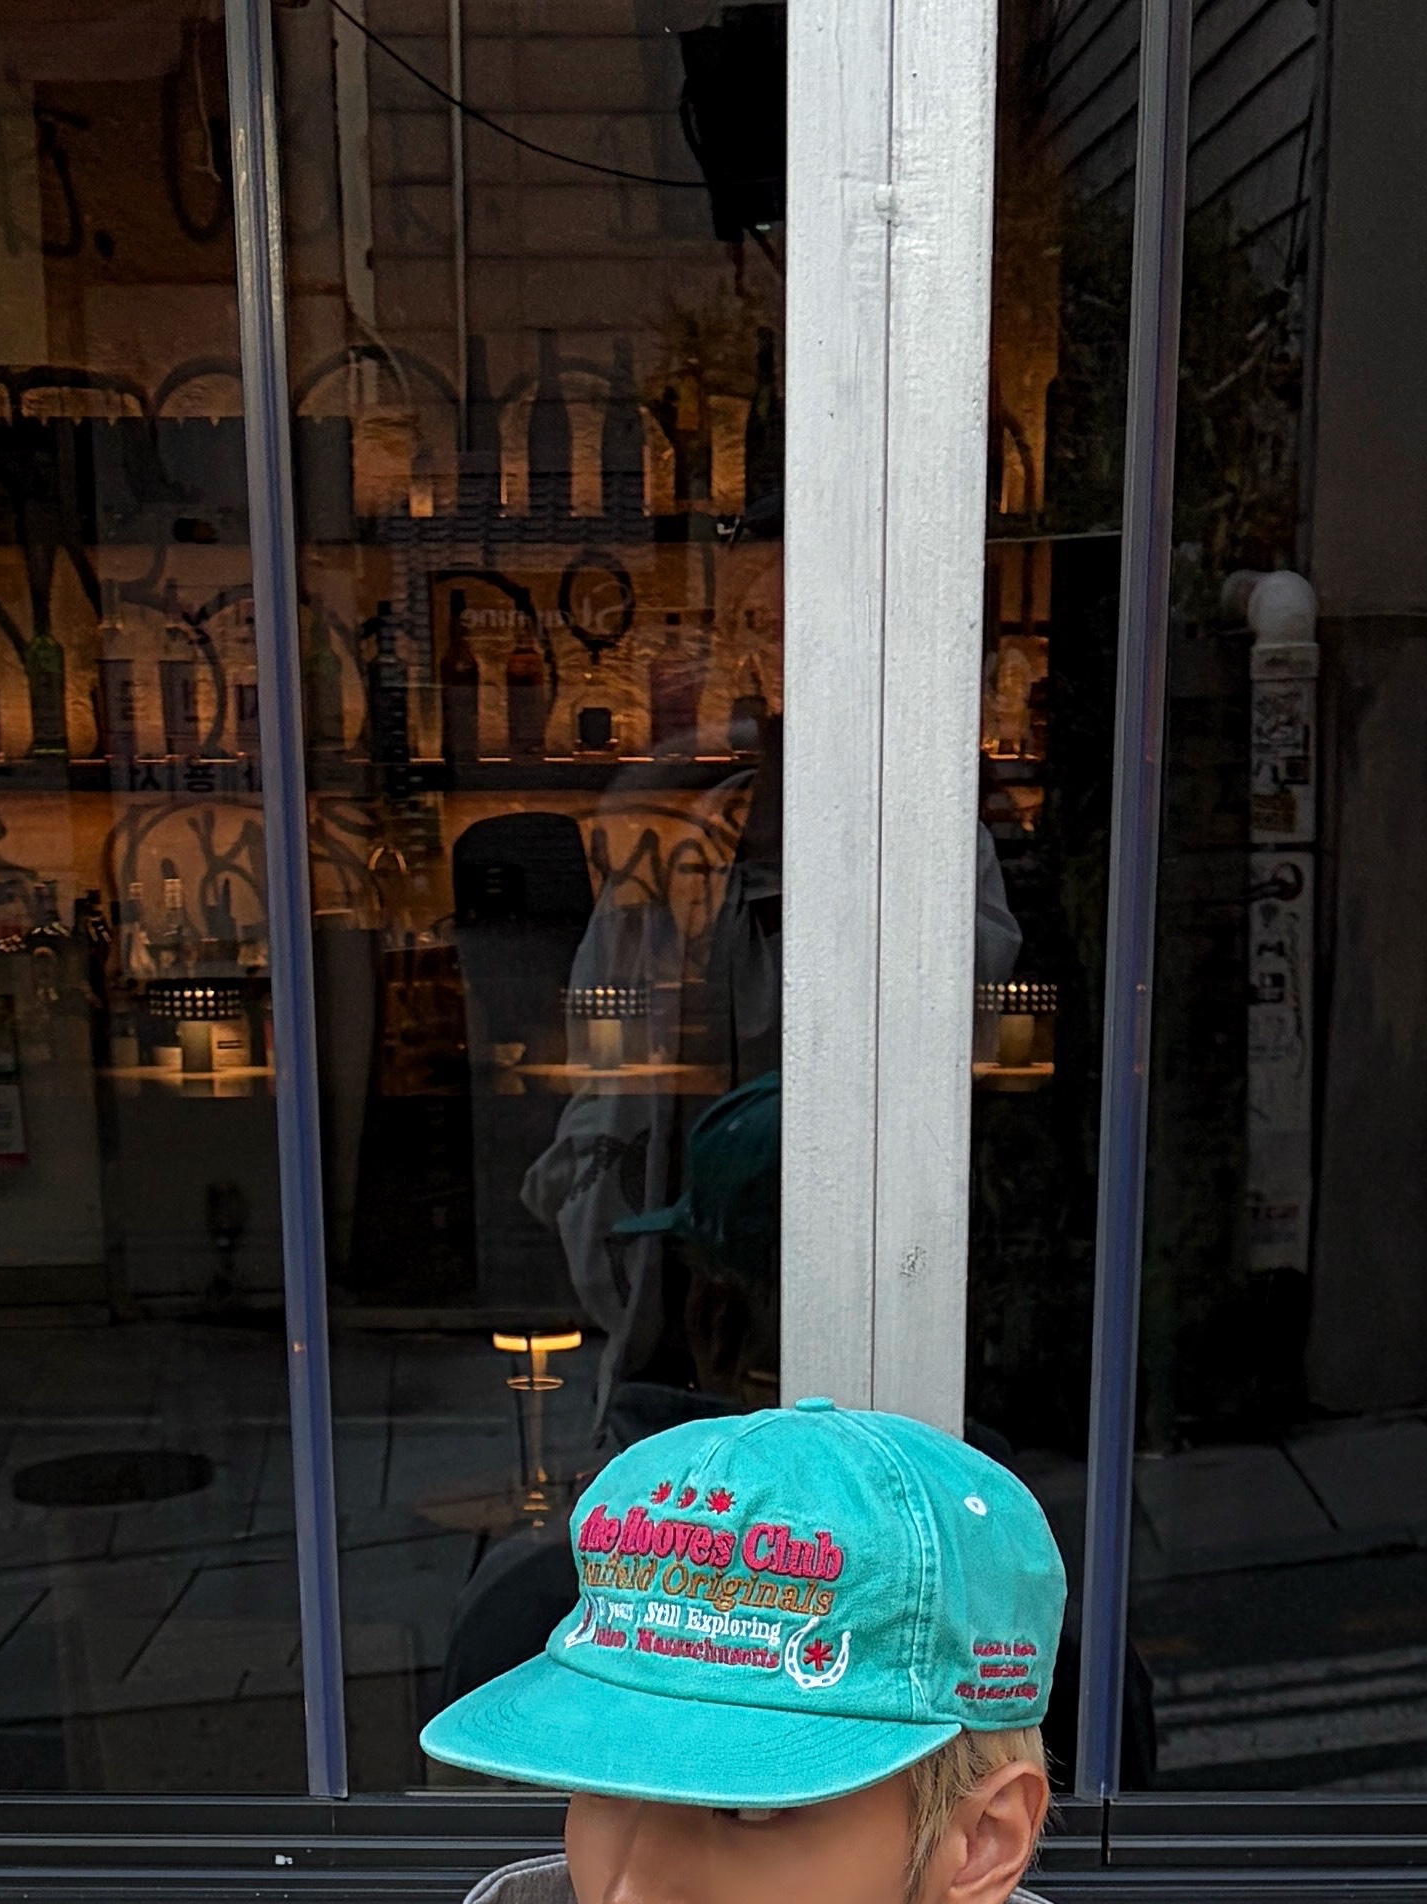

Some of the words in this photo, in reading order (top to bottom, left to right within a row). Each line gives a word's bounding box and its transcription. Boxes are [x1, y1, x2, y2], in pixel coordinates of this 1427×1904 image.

[620, 1506, 736, 1567] Hooves
[742, 1522, 844, 1582] Club
[662, 1563, 834, 1616] Originals
[644, 1601, 681, 1628] Still
[685, 1607, 782, 1646] Exploring
